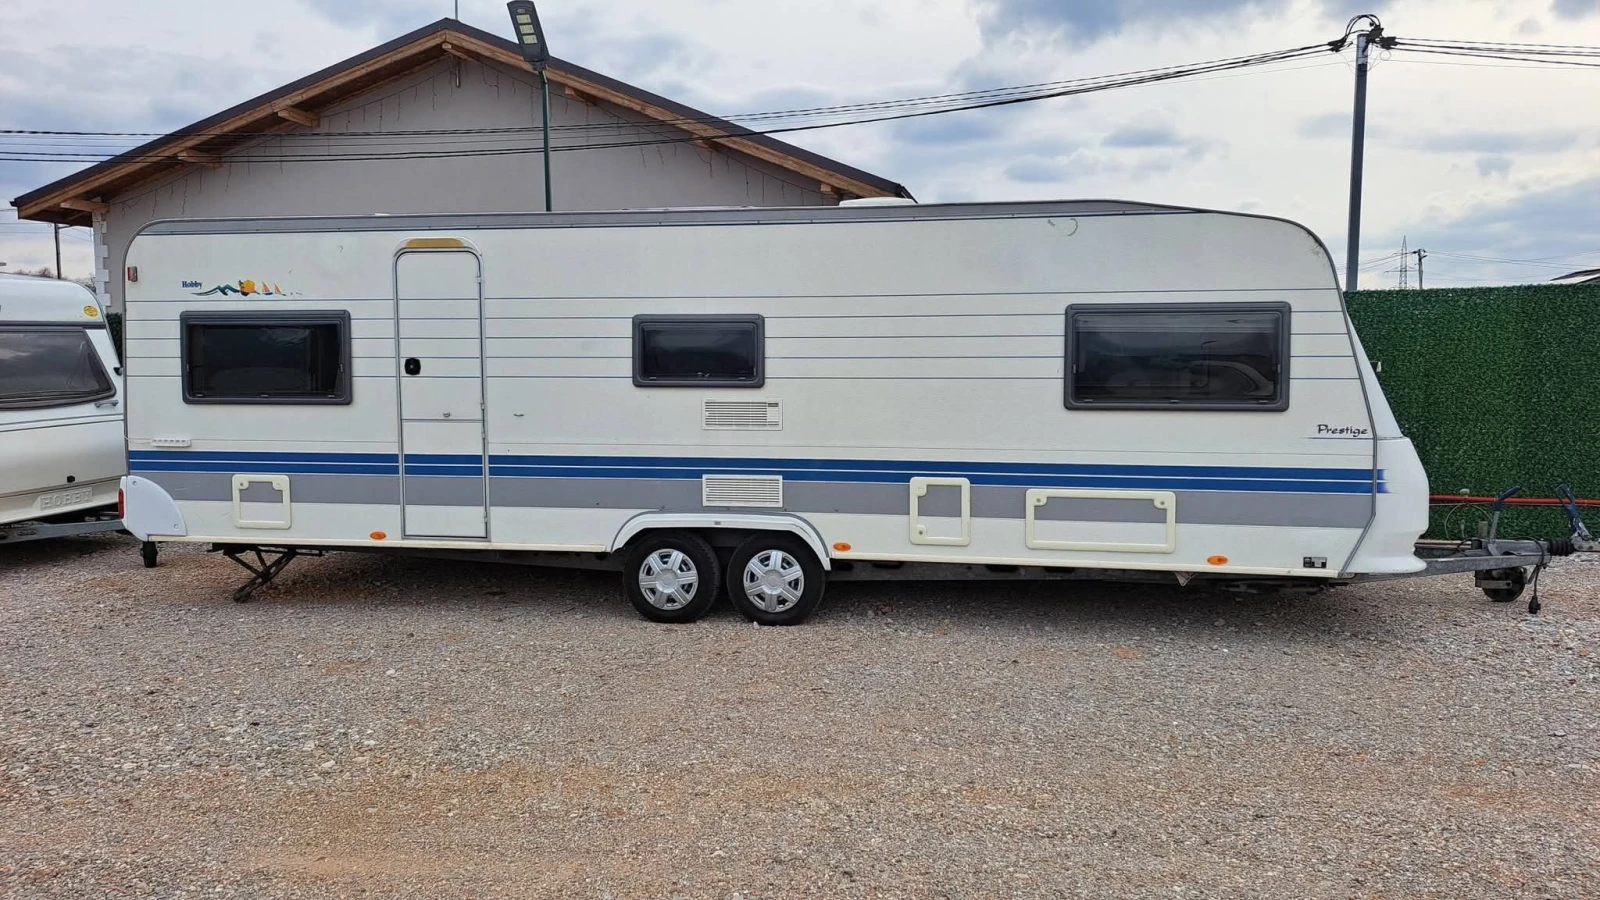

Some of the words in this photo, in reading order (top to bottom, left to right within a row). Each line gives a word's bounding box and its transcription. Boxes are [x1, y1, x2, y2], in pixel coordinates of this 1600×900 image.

[181, 280, 203, 289] Hobby
[1317, 424, 1368, 437] Prestige
[41, 489, 92, 509] HOBBY
